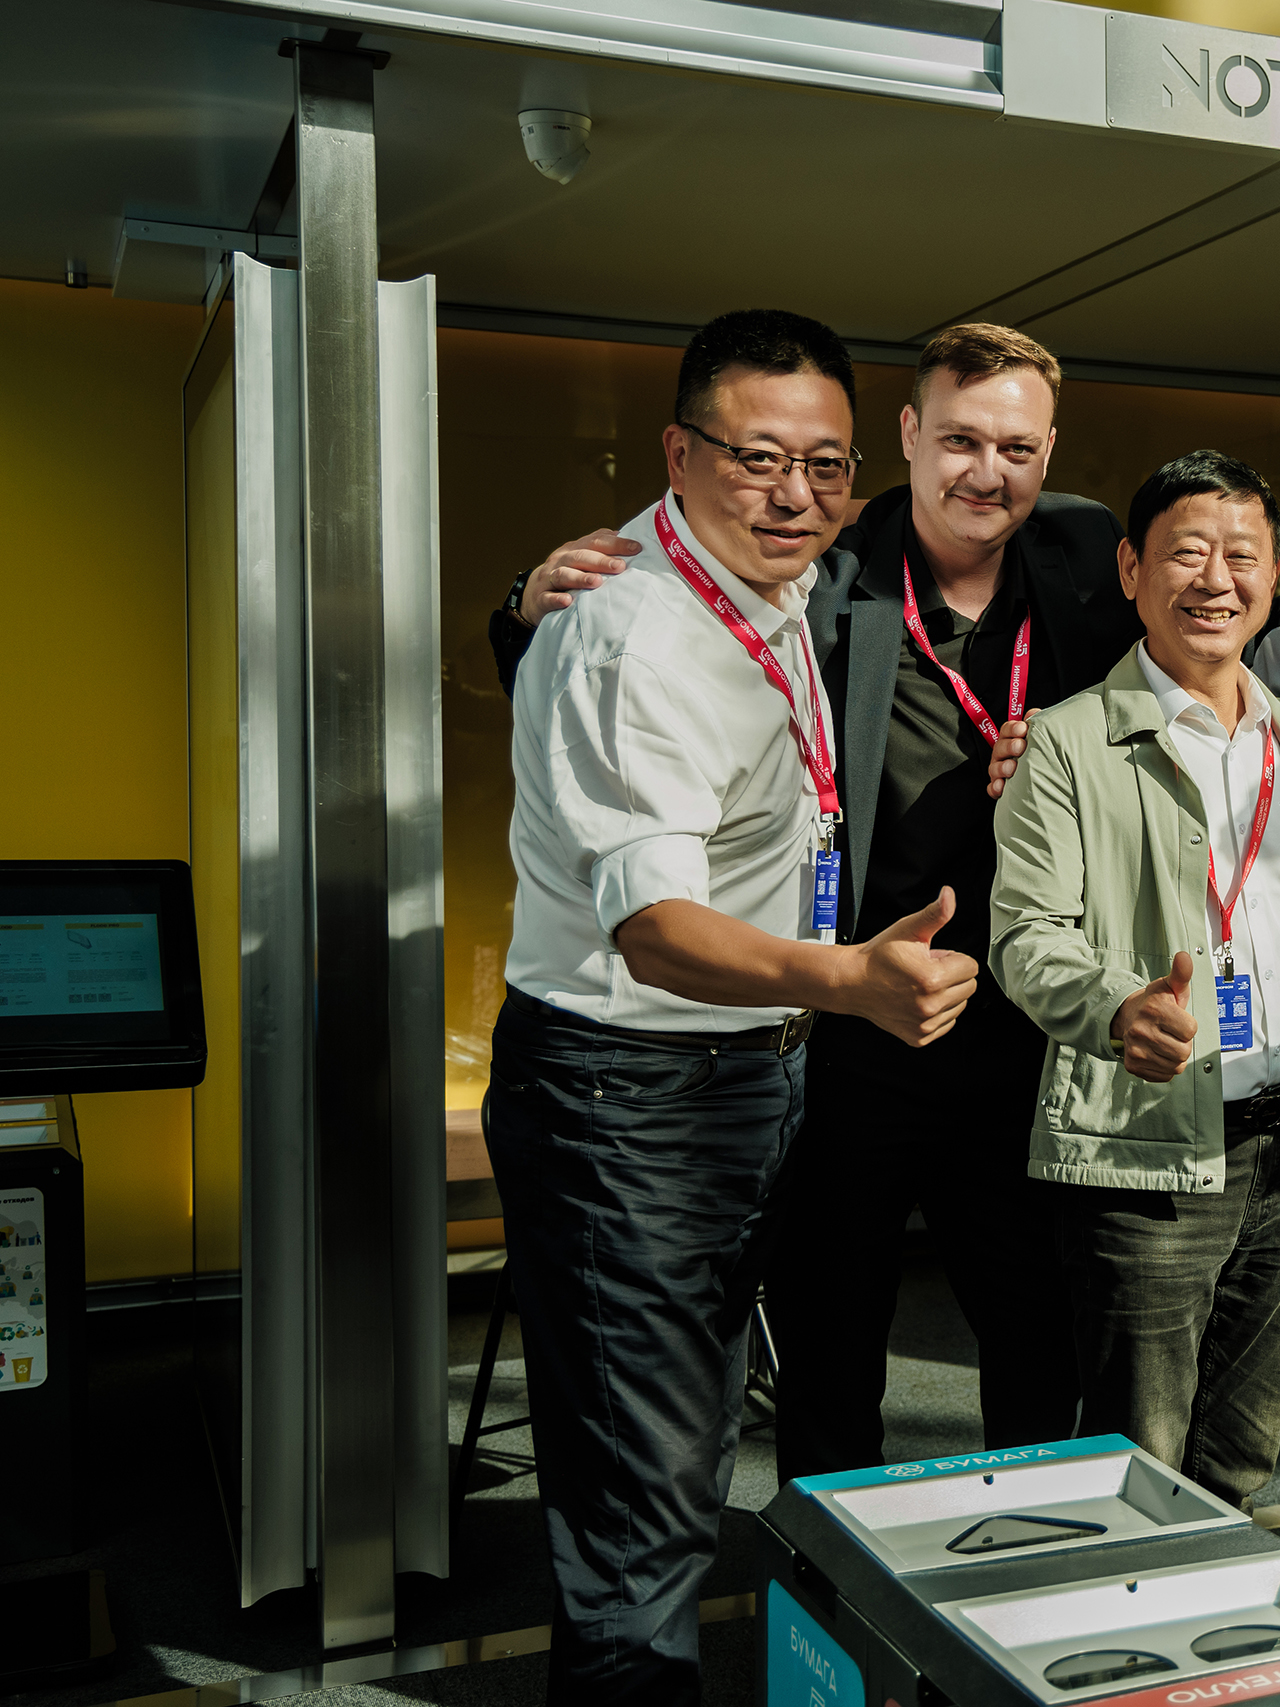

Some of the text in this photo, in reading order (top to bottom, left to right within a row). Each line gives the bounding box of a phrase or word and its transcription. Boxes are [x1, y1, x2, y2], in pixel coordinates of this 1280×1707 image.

[672, 542, 714, 588] ИННОПРОМ
[720, 598, 758, 640] INNOPROM
[1010, 665, 1020, 711] ИННОПРОМ
[933, 1448, 1057, 1471] БУМАГА
[790, 1624, 838, 1697] БУМАГА
